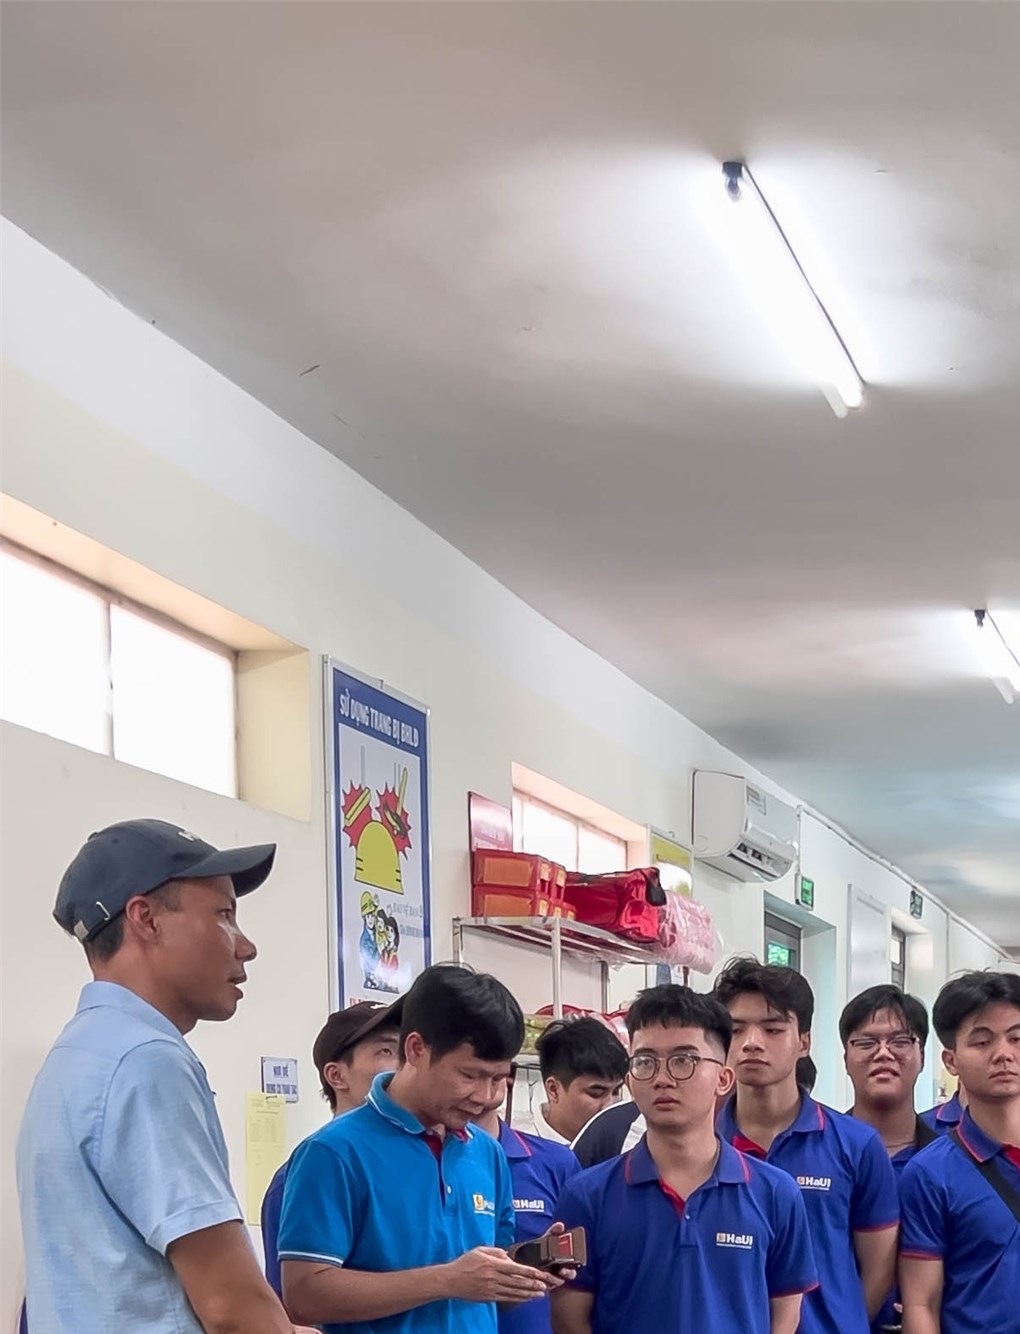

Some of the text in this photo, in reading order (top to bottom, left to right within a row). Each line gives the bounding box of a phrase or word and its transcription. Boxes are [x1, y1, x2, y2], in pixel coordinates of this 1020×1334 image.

[805, 1176, 831, 1188] HaUI
[520, 1199, 545, 1209] HaUI
[726, 1233, 753, 1246] HaUI
